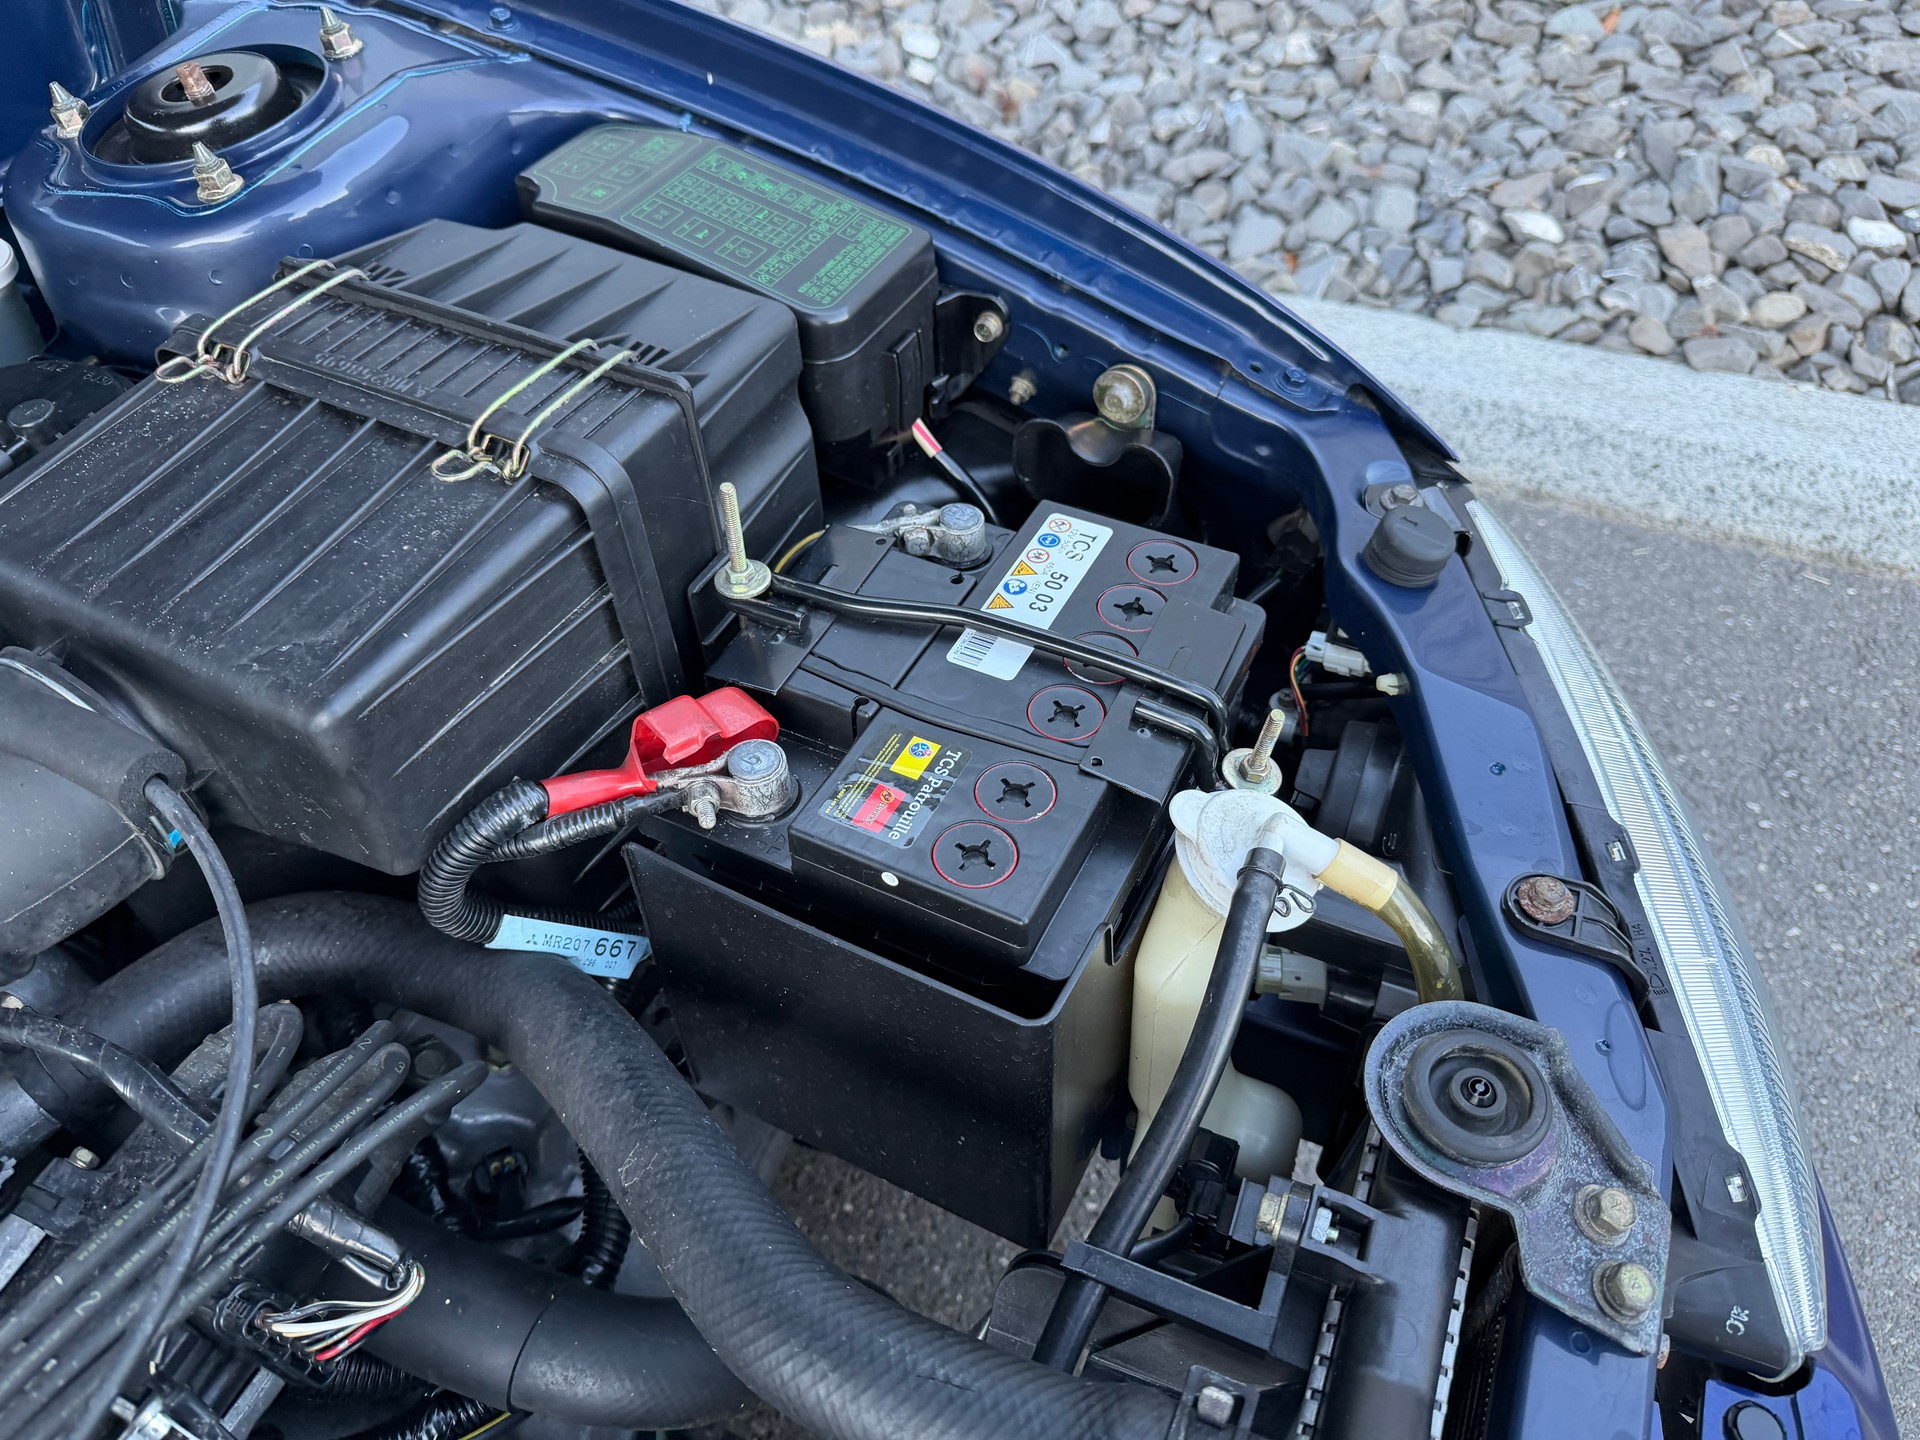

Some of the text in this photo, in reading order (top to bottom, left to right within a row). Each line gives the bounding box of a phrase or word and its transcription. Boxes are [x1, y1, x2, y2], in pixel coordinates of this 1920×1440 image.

[1029, 533, 1098, 612] TCS 50 03
[888, 751, 962, 840] TCS Patrouille
[358, 1038, 372, 1050] 2
[395, 1062, 406, 1074] 3
[441, 1079, 457, 1090] 4
[330, 1105, 362, 1133] YAZAKI
[253, 1128, 273, 1147] 2
[263, 1169, 284, 1187] 3
[315, 1169, 335, 1183] 4
[74, 1291, 101, 1317] 2
